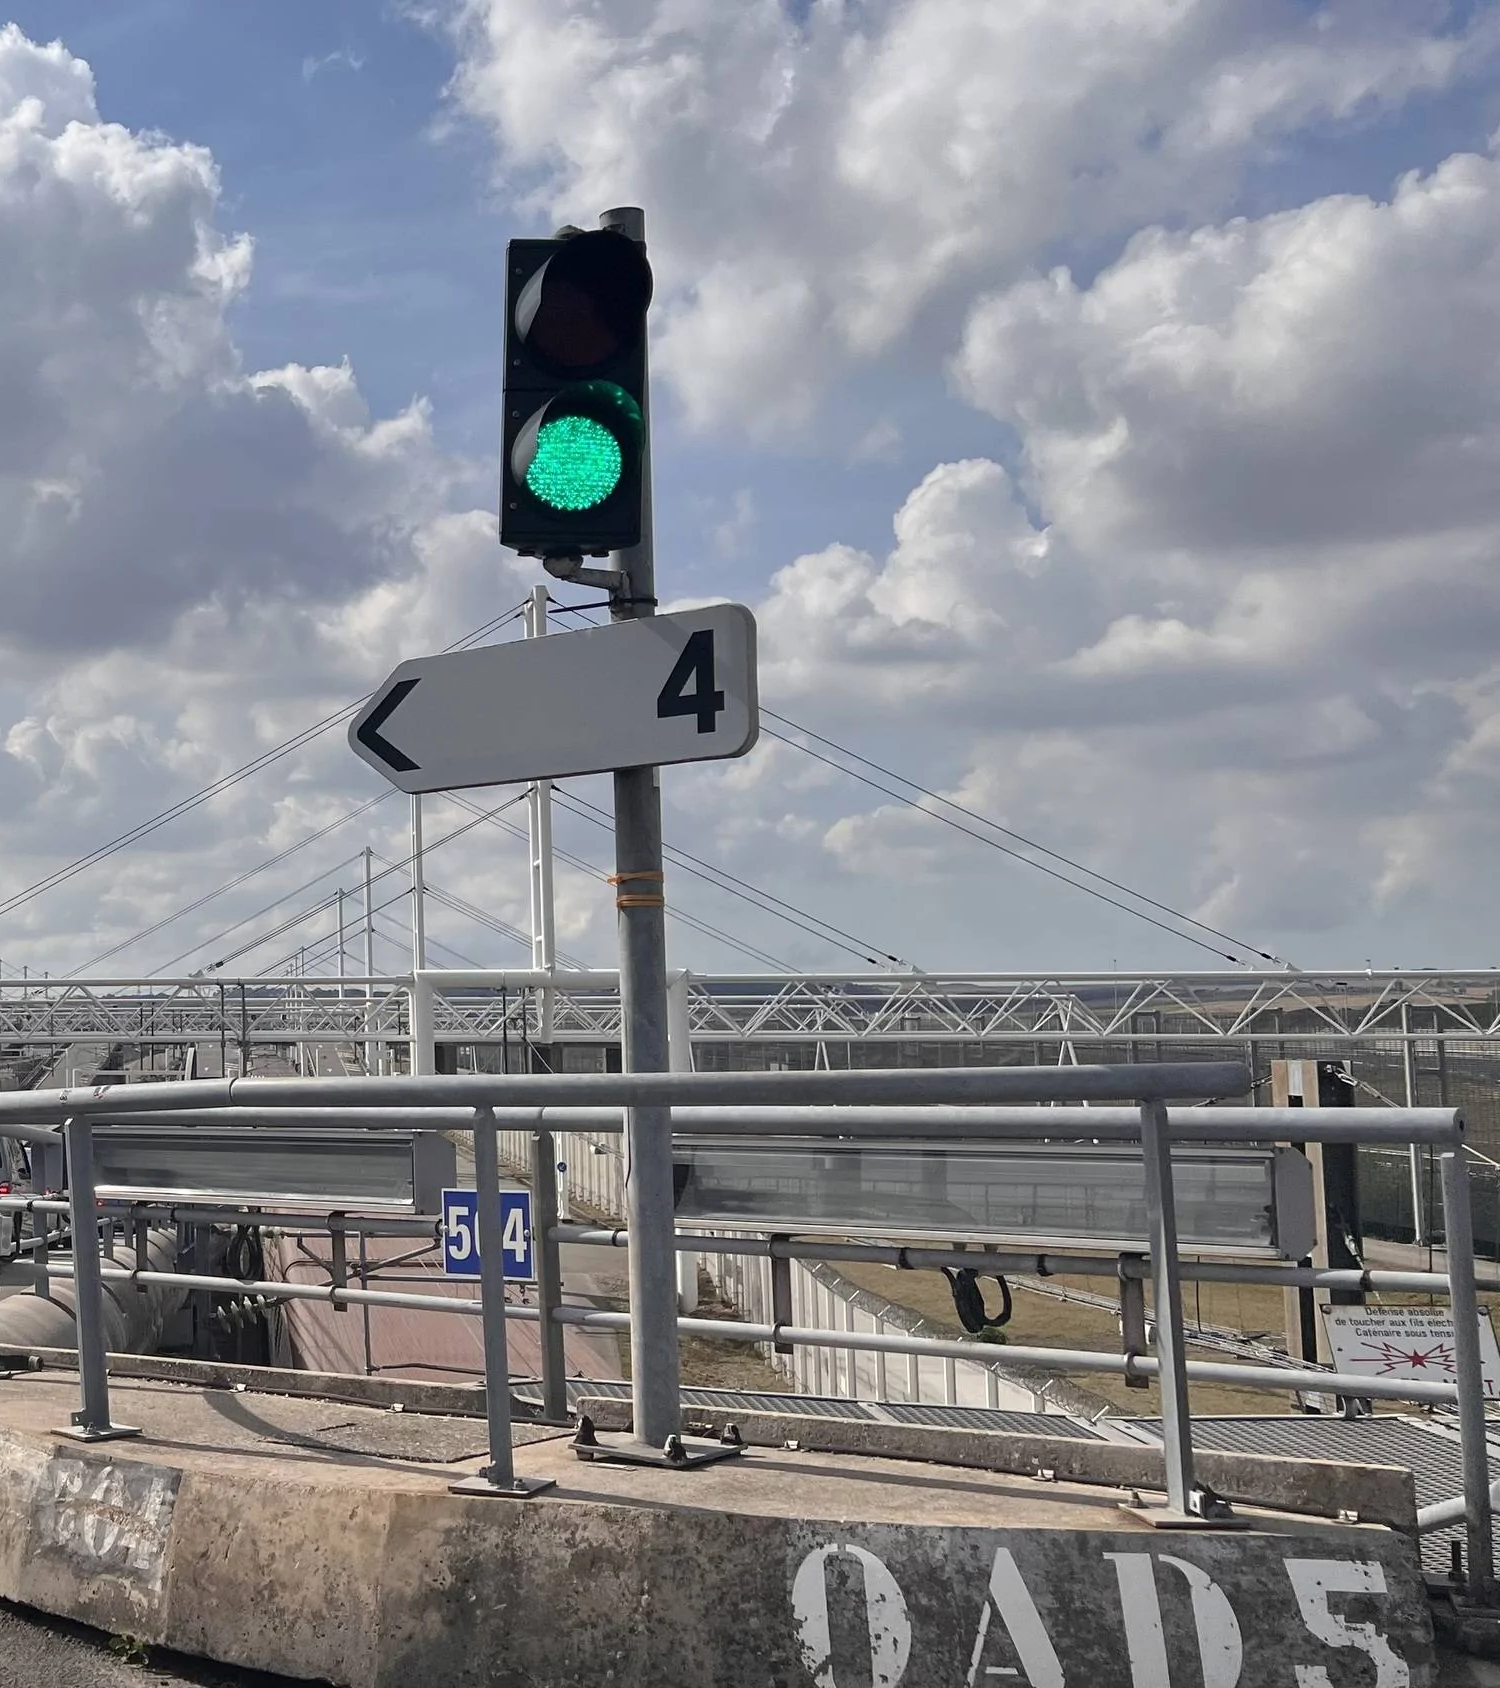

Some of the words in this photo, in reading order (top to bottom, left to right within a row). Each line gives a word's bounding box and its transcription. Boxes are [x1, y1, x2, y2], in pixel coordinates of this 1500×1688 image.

[657, 628, 725, 734] 4
[448, 1205, 528, 1263] 54
[1407, 1306, 1444, 1317] absolue
[1335, 1317, 1347, 1326] de
[1349, 1317, 1385, 1327] toucher
[1389, 1319, 1407, 1328] aux
[1409, 1318, 1425, 1327] fils
[1404, 1329, 1427, 1338] sous
